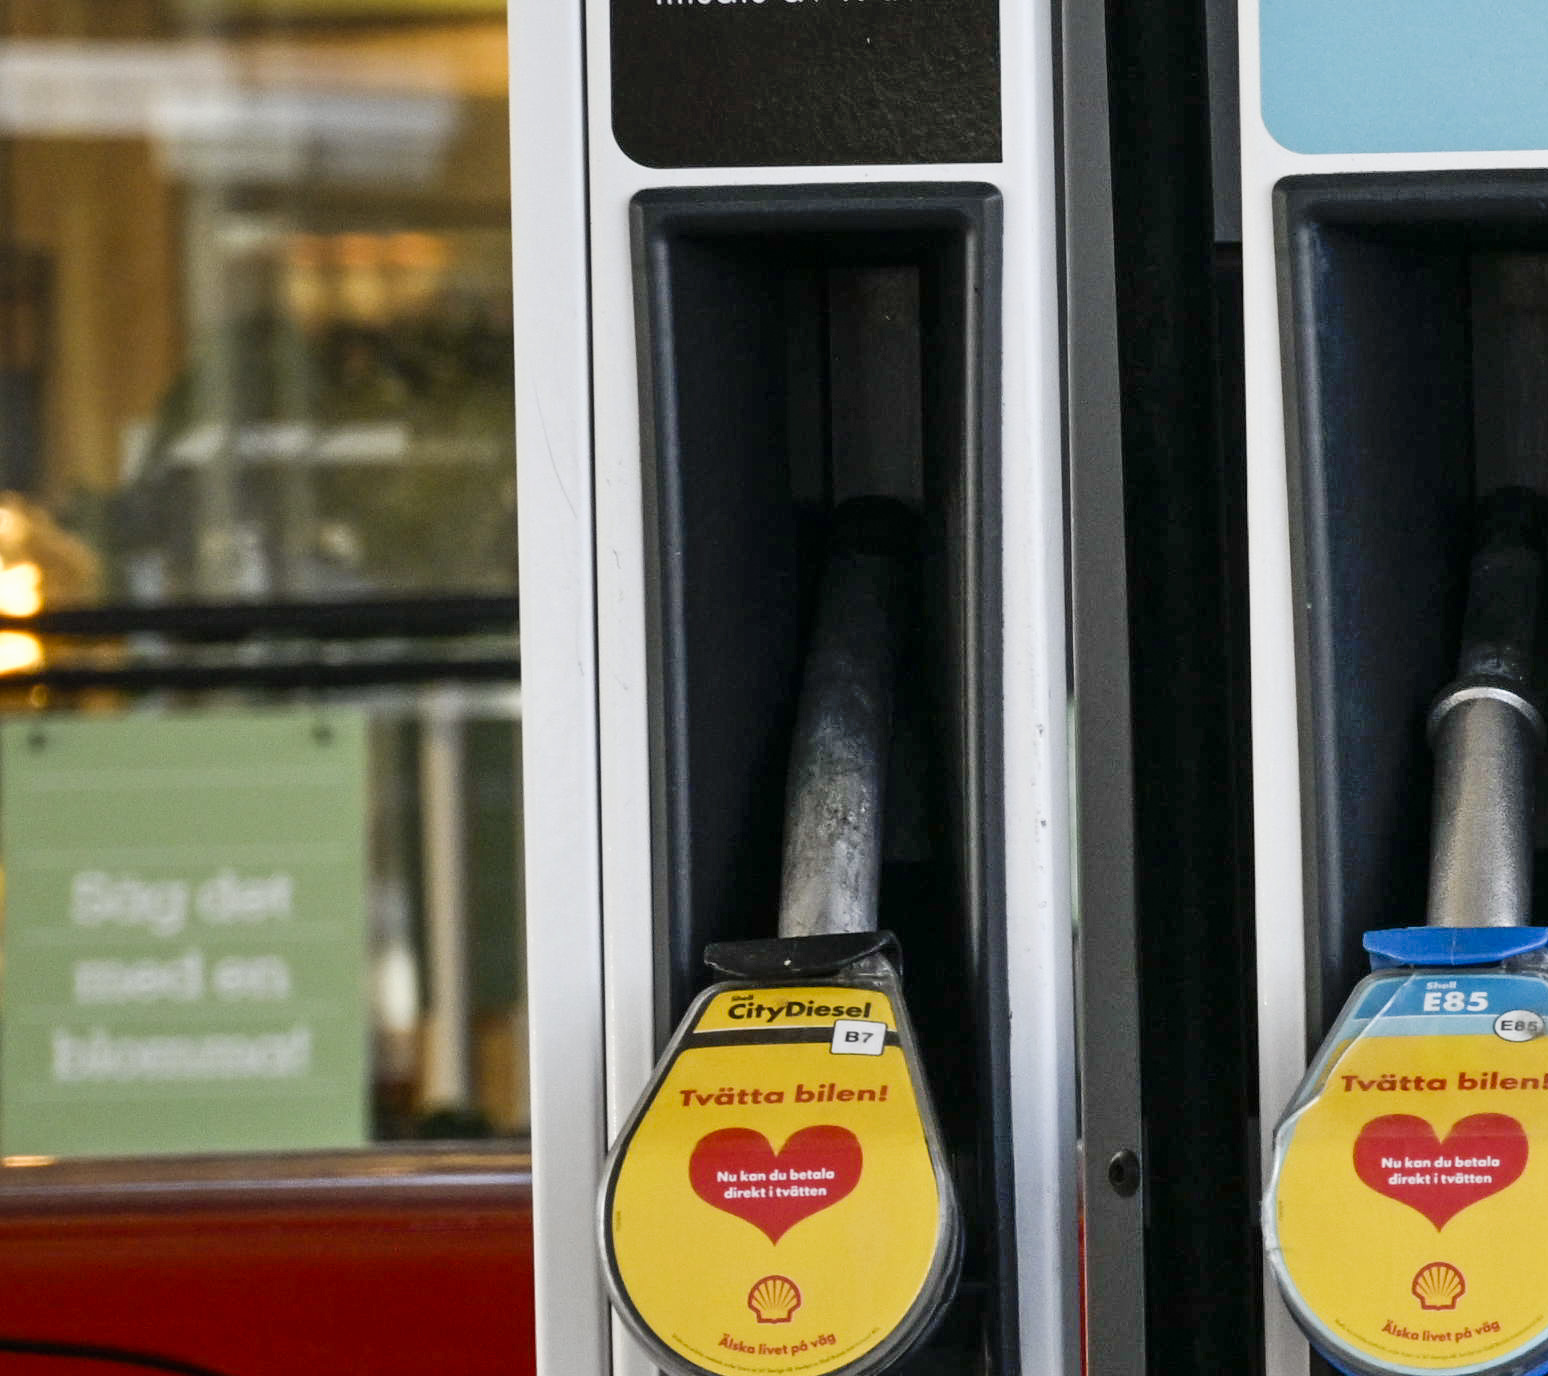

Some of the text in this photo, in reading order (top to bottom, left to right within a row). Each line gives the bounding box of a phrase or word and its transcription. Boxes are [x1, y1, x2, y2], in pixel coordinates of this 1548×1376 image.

[1426, 981, 1457, 990] Shell
[1424, 991, 1489, 1012] E85
[728, 1001, 871, 1023] CityDiesel
[1500, 1020, 1538, 1032] E85
[845, 1031, 873, 1043] B7
[1341, 1074, 1447, 1092] Tvätta
[680, 1083, 888, 1107] Tvätta bilen!
